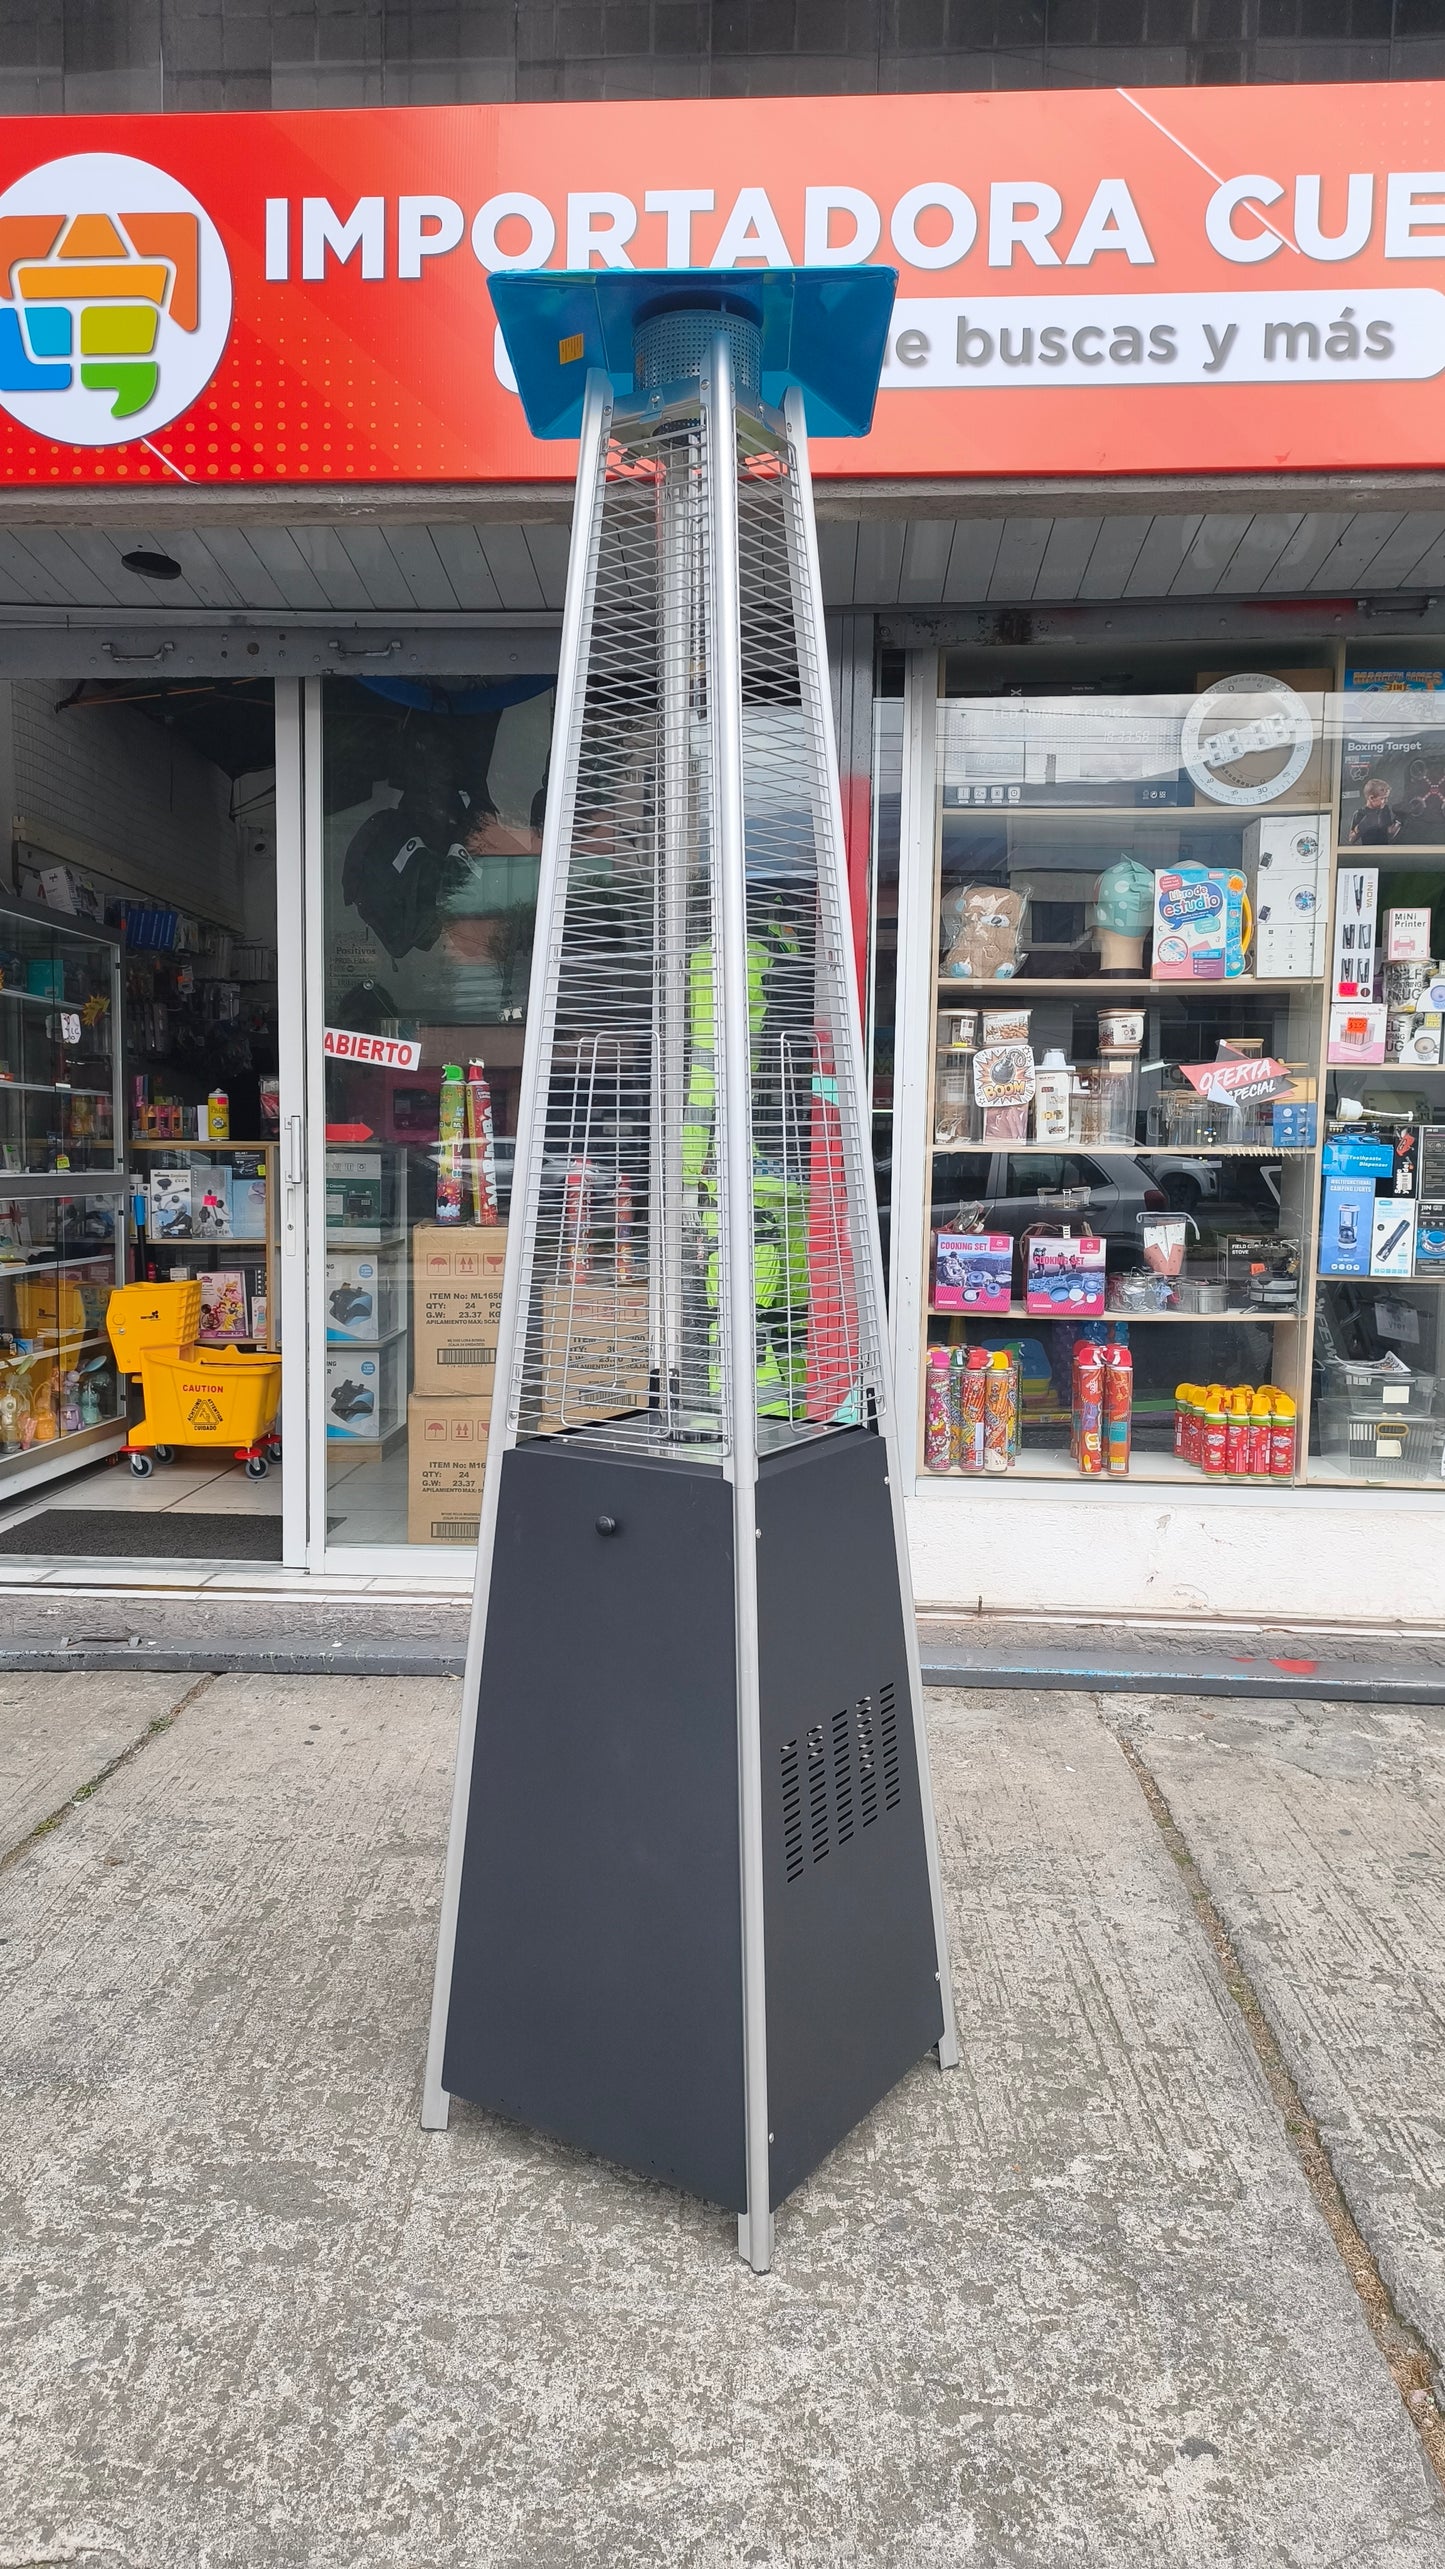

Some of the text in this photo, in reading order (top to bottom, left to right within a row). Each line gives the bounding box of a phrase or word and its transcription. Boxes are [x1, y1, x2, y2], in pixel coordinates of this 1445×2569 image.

[265, 179, 1156, 281] IMPORTADORA
[956, 315, 1178, 368] buscas
[1201, 323, 1237, 370] y
[1262, 307, 1394, 360] más
[1347, 741, 1422, 753] Boxing Target
[1168, 884, 1208, 902] Libro de
[1163, 894, 1221, 917] estudio
[1394, 920, 1427, 928] Printer
[324, 1032, 413, 1065] ABIERTO
[1199, 1059, 1272, 1091] OFERTA
[983, 1081, 1025, 1101] BOOM
[1226, 1080, 1276, 1101] SPECIAL
[1349, 1154, 1382, 1162] Toothpaste
[940, 1241, 973, 1251] COOKING
[974, 1242, 988, 1251] SET
[1033, 1256, 1085, 1266] COOKING SET
[429, 1292, 451, 1300] ITEM
[453, 1292, 468, 1300] No:
[425, 1302, 446, 1310] QTY:
[458, 1311, 482, 1319] 23.37
[182, 1384, 224, 1393] CAUTION
[207, 1398, 224, 1422] ATTENTION
[429, 1461, 451, 1469] ITEM
